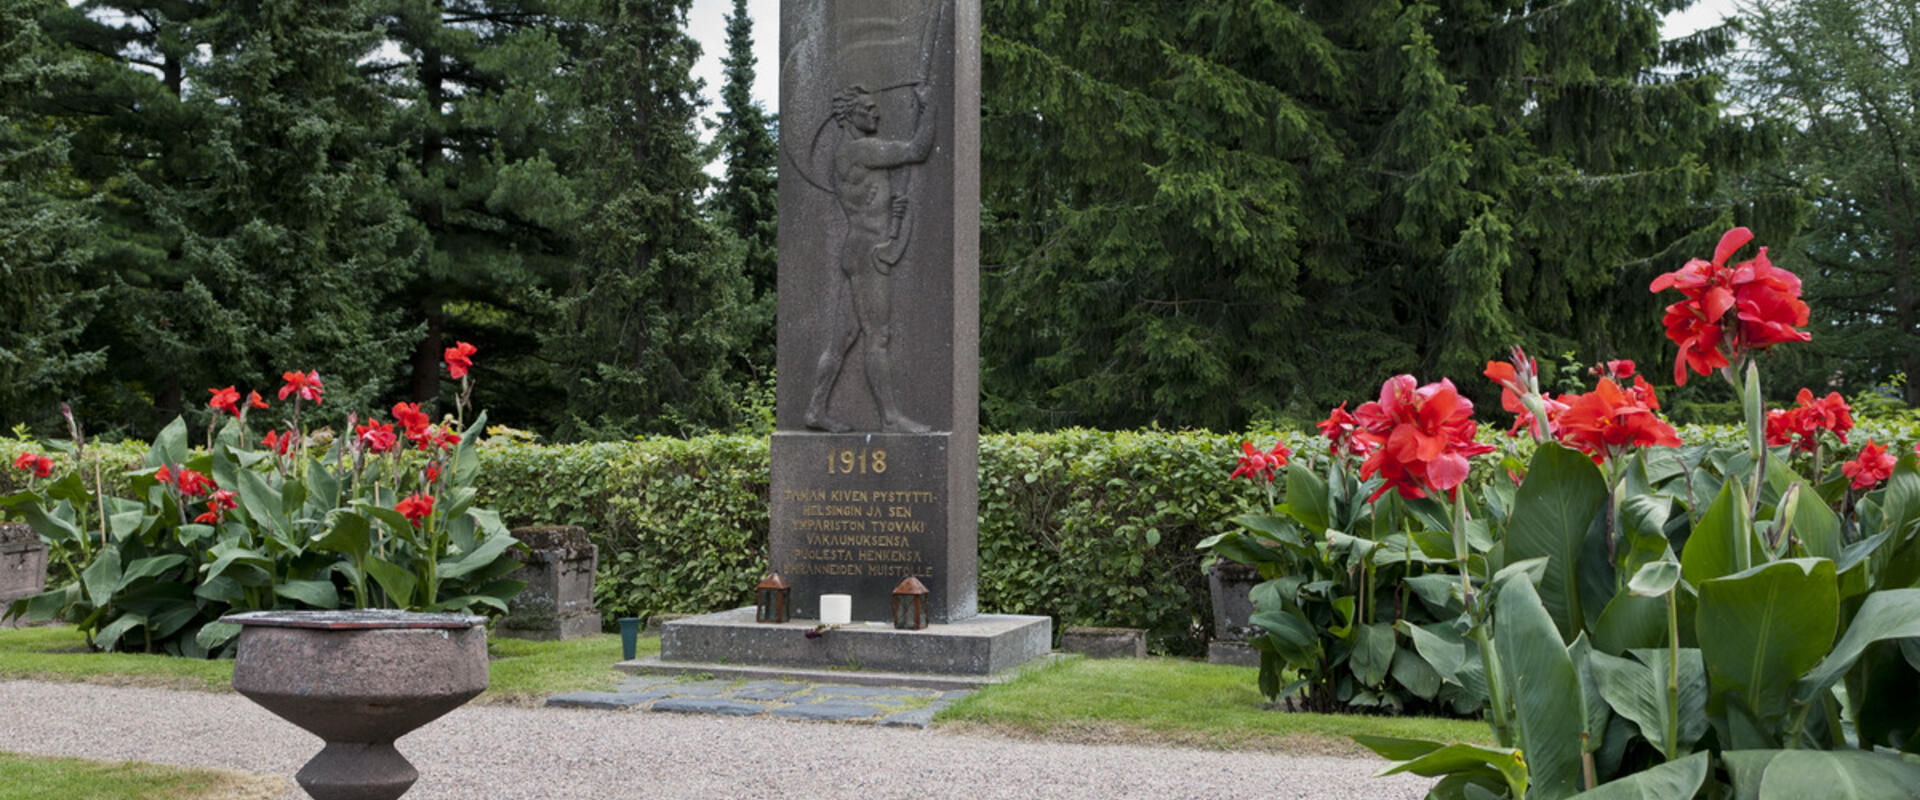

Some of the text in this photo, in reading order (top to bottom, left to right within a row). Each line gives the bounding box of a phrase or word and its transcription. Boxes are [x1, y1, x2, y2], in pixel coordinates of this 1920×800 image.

[828, 448, 888, 474] 1918
[831, 489, 868, 502] KIVEN
[802, 504, 912, 518] HELSINGIN JA SEN
[793, 548, 853, 561] PUOLESTA
[867, 564, 934, 577] MUISTOLLE
